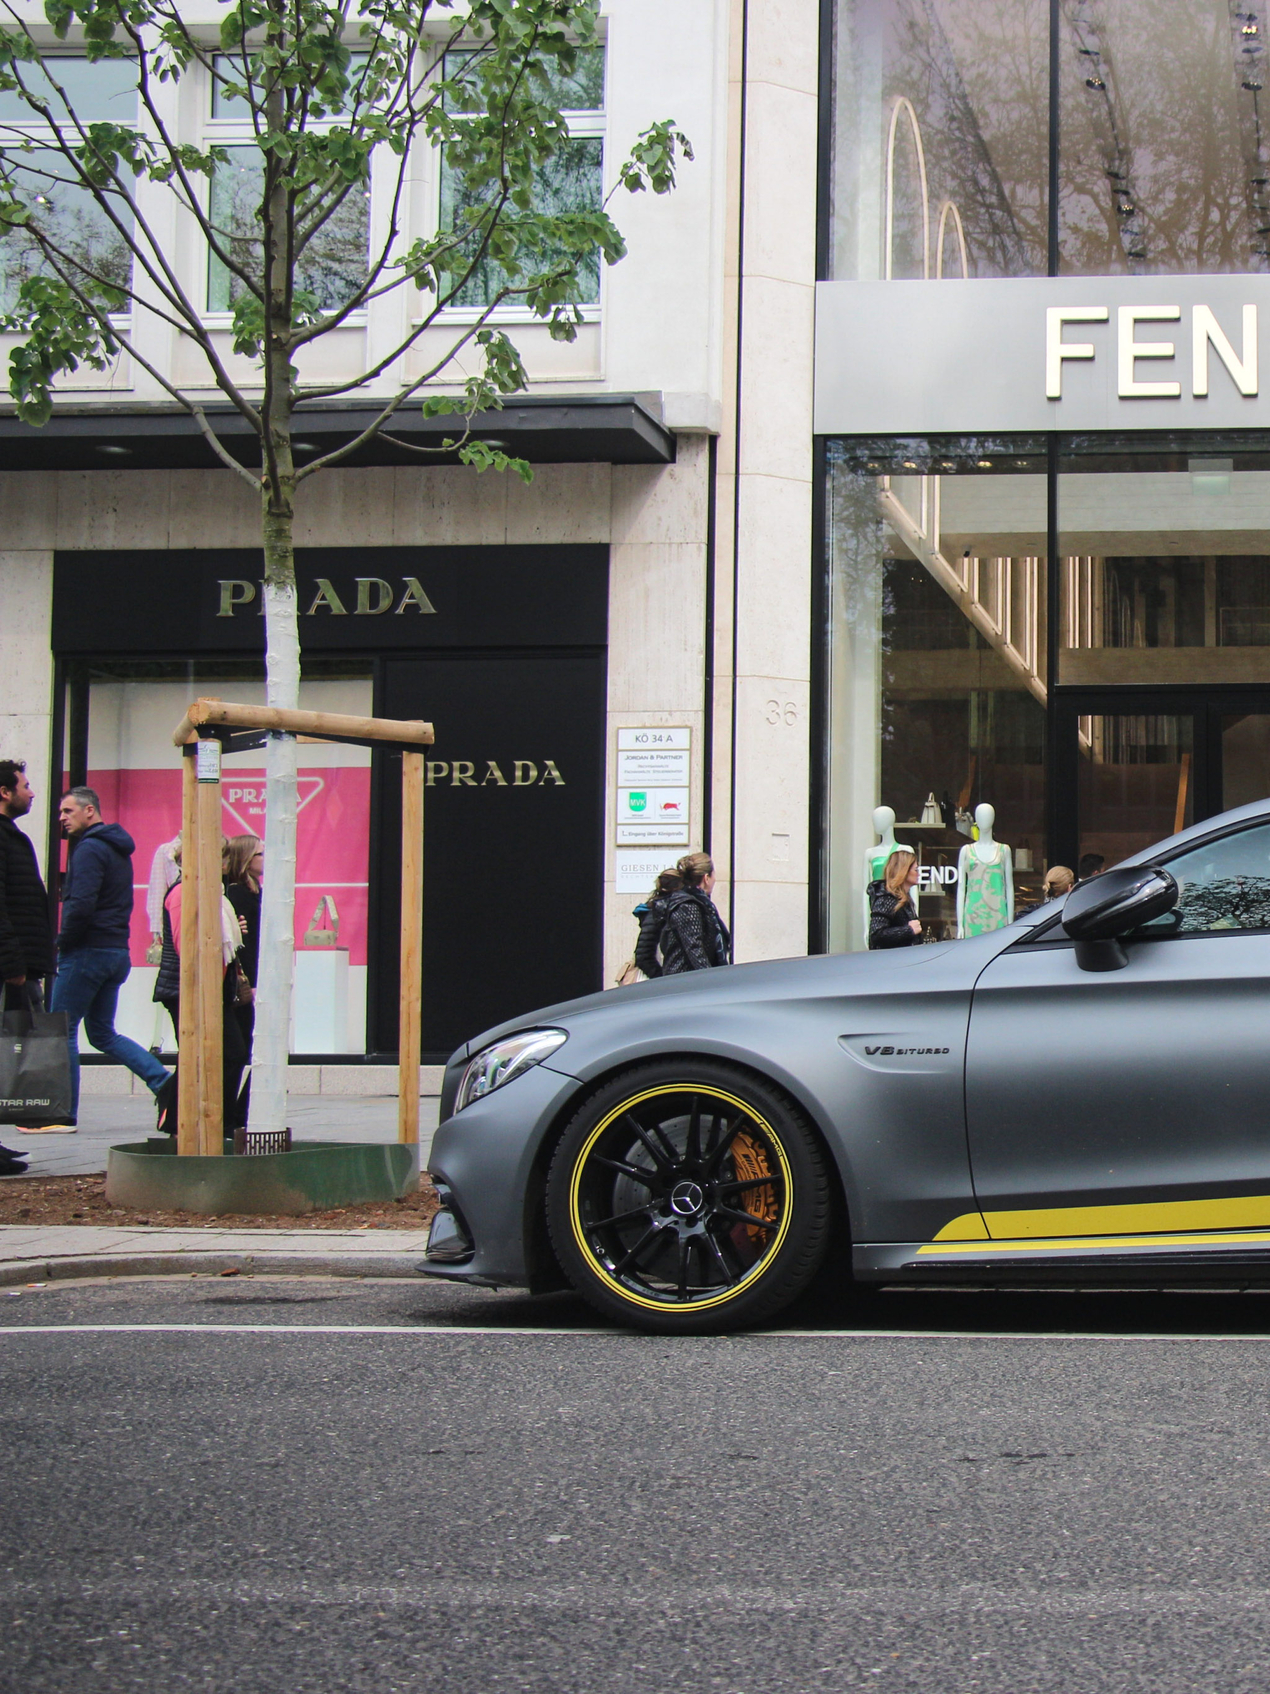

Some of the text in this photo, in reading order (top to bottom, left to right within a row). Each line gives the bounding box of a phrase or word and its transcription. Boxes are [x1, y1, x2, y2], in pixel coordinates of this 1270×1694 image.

[216, 577, 438, 617] PADA
[766, 699, 797, 727] 36
[635, 733, 673, 743] KÖ 34 A
[425, 760, 566, 786] PRADA
[229, 788, 302, 803] PRA
[918, 866, 963, 885] ENDI
[864, 1046, 895, 1055] V8
